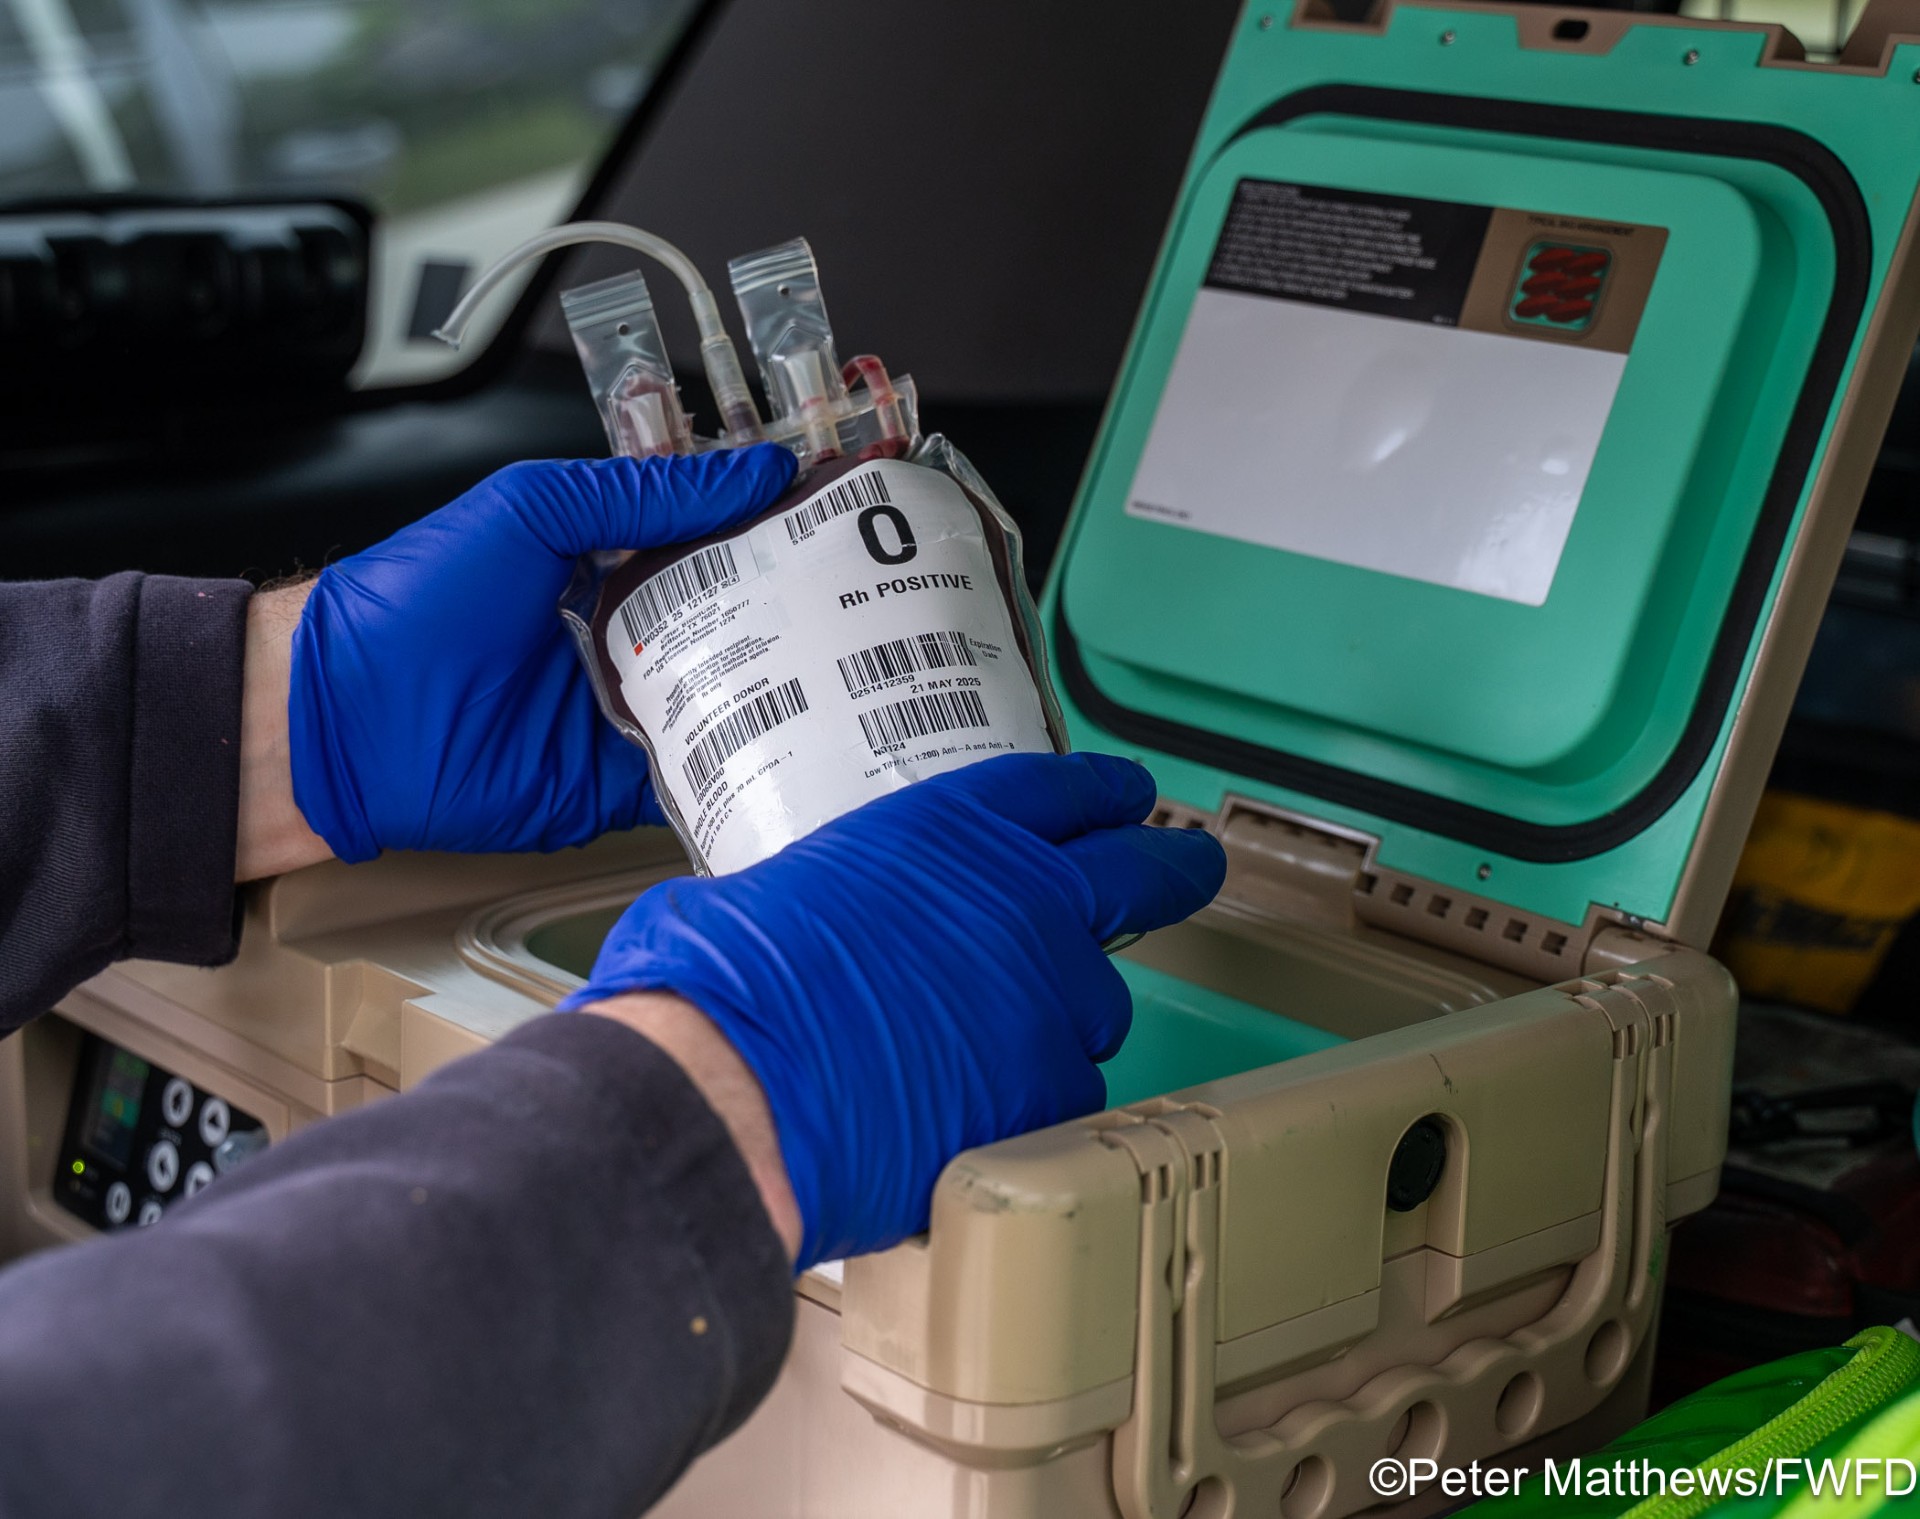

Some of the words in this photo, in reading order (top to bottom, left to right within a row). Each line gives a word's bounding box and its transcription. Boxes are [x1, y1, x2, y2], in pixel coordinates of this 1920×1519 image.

[792, 529, 816, 546] 5100
[839, 590, 870, 610] Rh
[876, 574, 974, 598] POSITIVE
[642, 620, 669, 647] W0352
[672, 610, 683, 622] 25
[687, 586, 718, 610] 121127
[688, 622, 698, 630] TX
[643, 667, 654, 680] FDA
[654, 636, 690, 666] Registration
[692, 618, 719, 636] Number
[656, 664, 664, 674] US
[664, 644, 688, 664] License
[690, 626, 718, 646] Number
[719, 614, 736, 627] 1274
[698, 650, 722, 668] intended
[850, 674, 915, 700] 0251412359
[910, 684, 924, 694] 21
[928, 680, 952, 690] MAY
[956, 678, 982, 687] 2025
[685, 700, 731, 746] VOLUNTEER
[733, 678, 770, 703] DONOR
[864, 766, 882, 778] Low
[973, 742, 987, 750] and
[694, 808, 708, 838] WHOLE
[706, 781, 728, 811] BLOOD
[722, 792, 736, 808] plus
